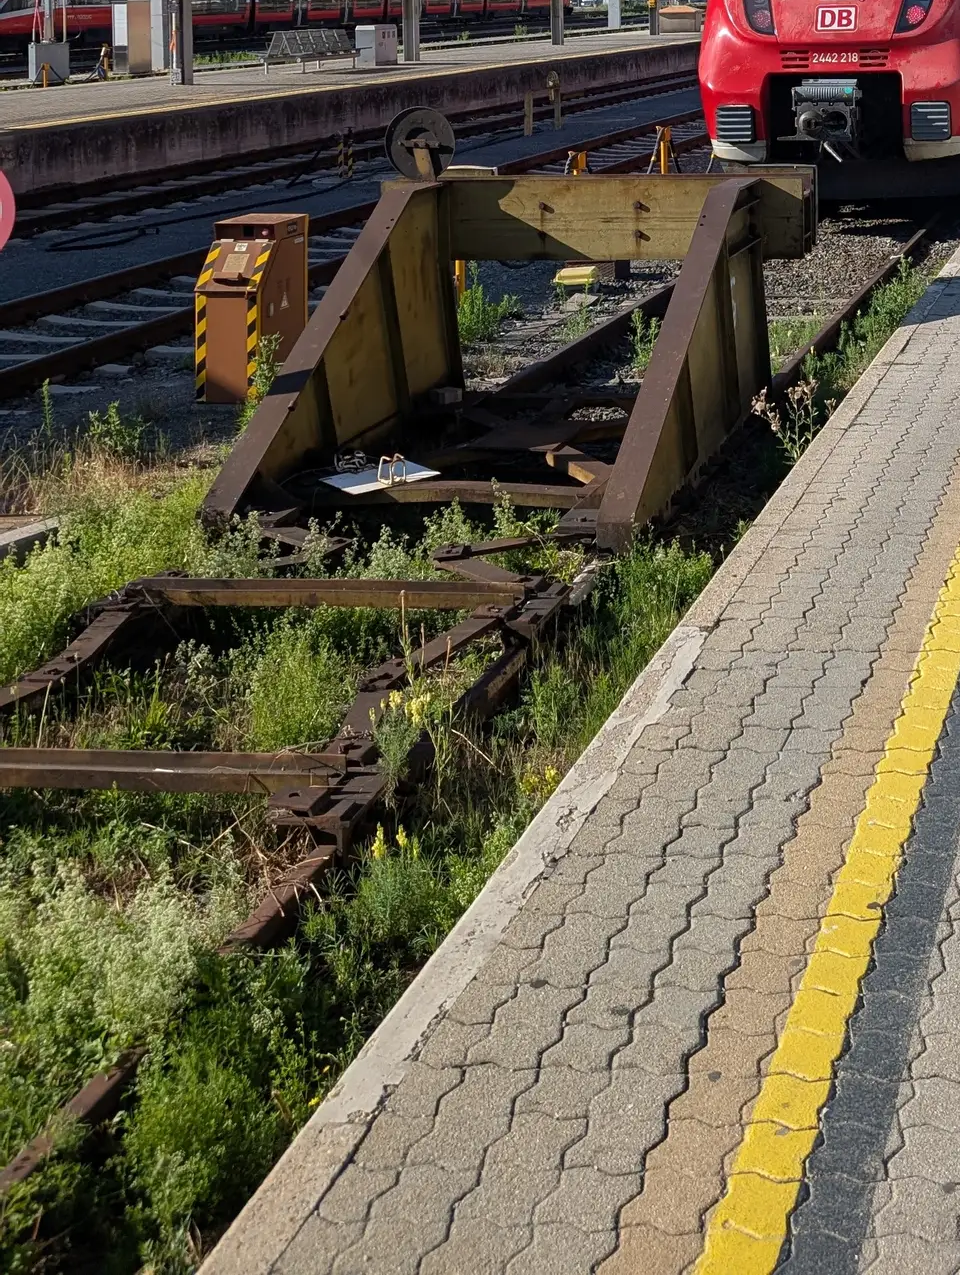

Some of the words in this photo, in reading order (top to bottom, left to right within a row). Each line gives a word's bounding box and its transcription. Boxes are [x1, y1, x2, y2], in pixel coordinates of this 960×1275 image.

[820, 9, 853, 28] DB
[812, 52, 838, 64] 2442
[840, 52, 859, 63] 218
